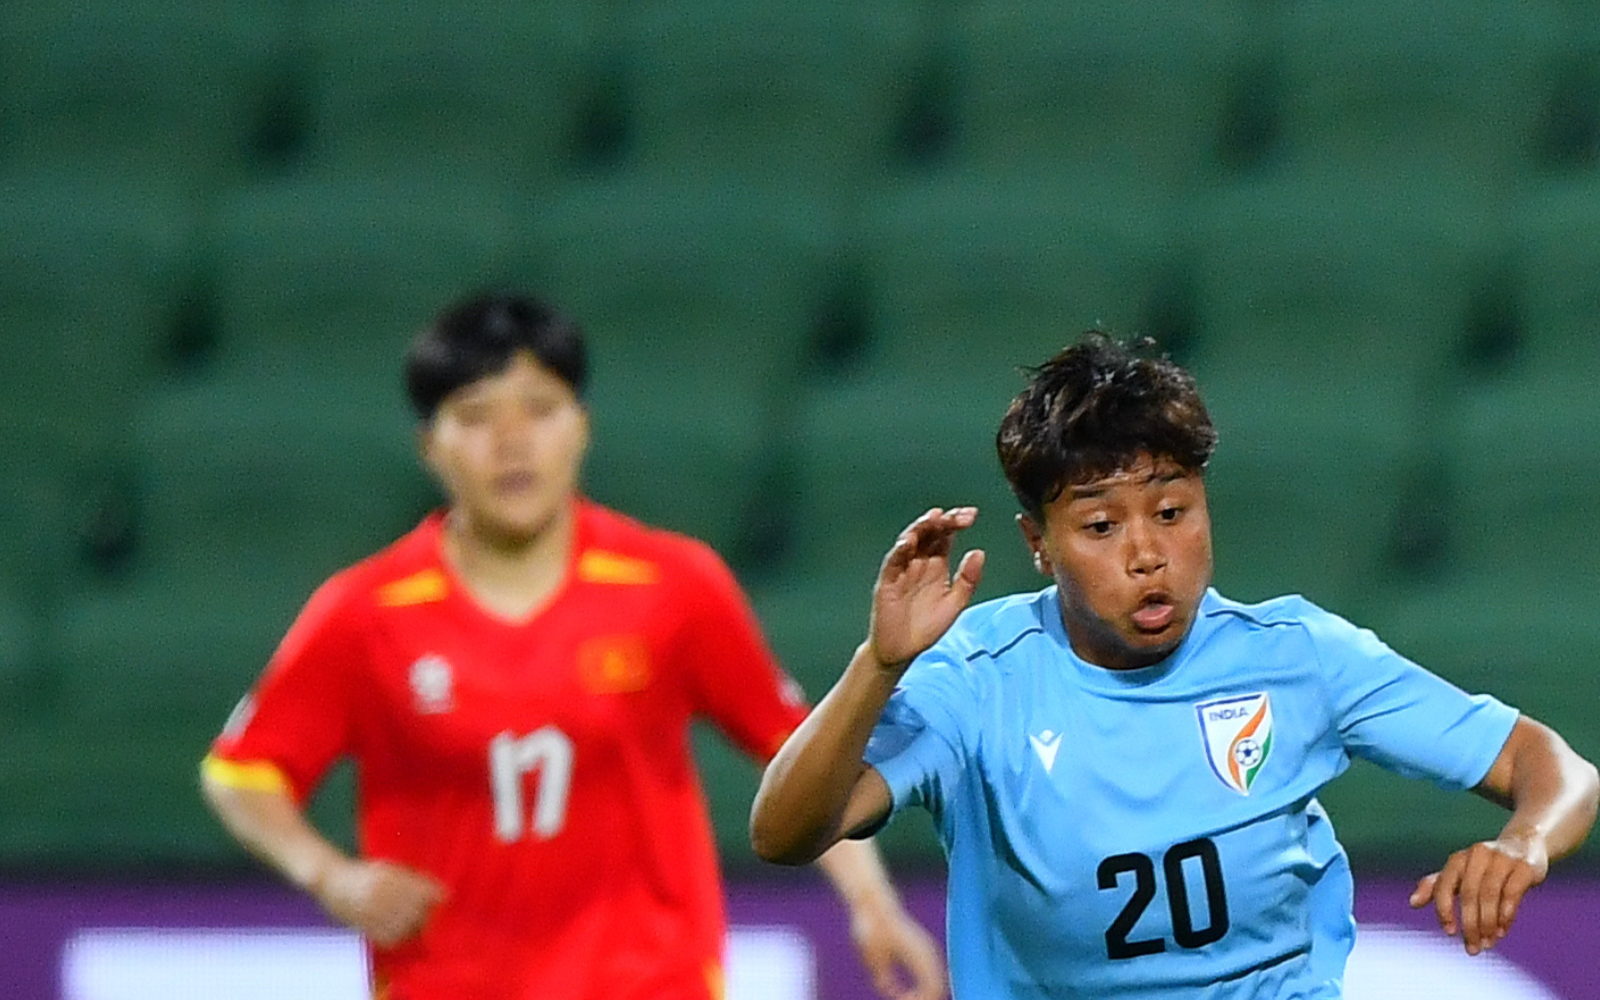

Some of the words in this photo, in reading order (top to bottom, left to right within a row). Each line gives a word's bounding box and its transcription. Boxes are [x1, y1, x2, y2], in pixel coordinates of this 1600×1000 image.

[1208, 706, 1249, 722] INDIA
[490, 723, 575, 843] 17
[1097, 837, 1230, 960] 20
